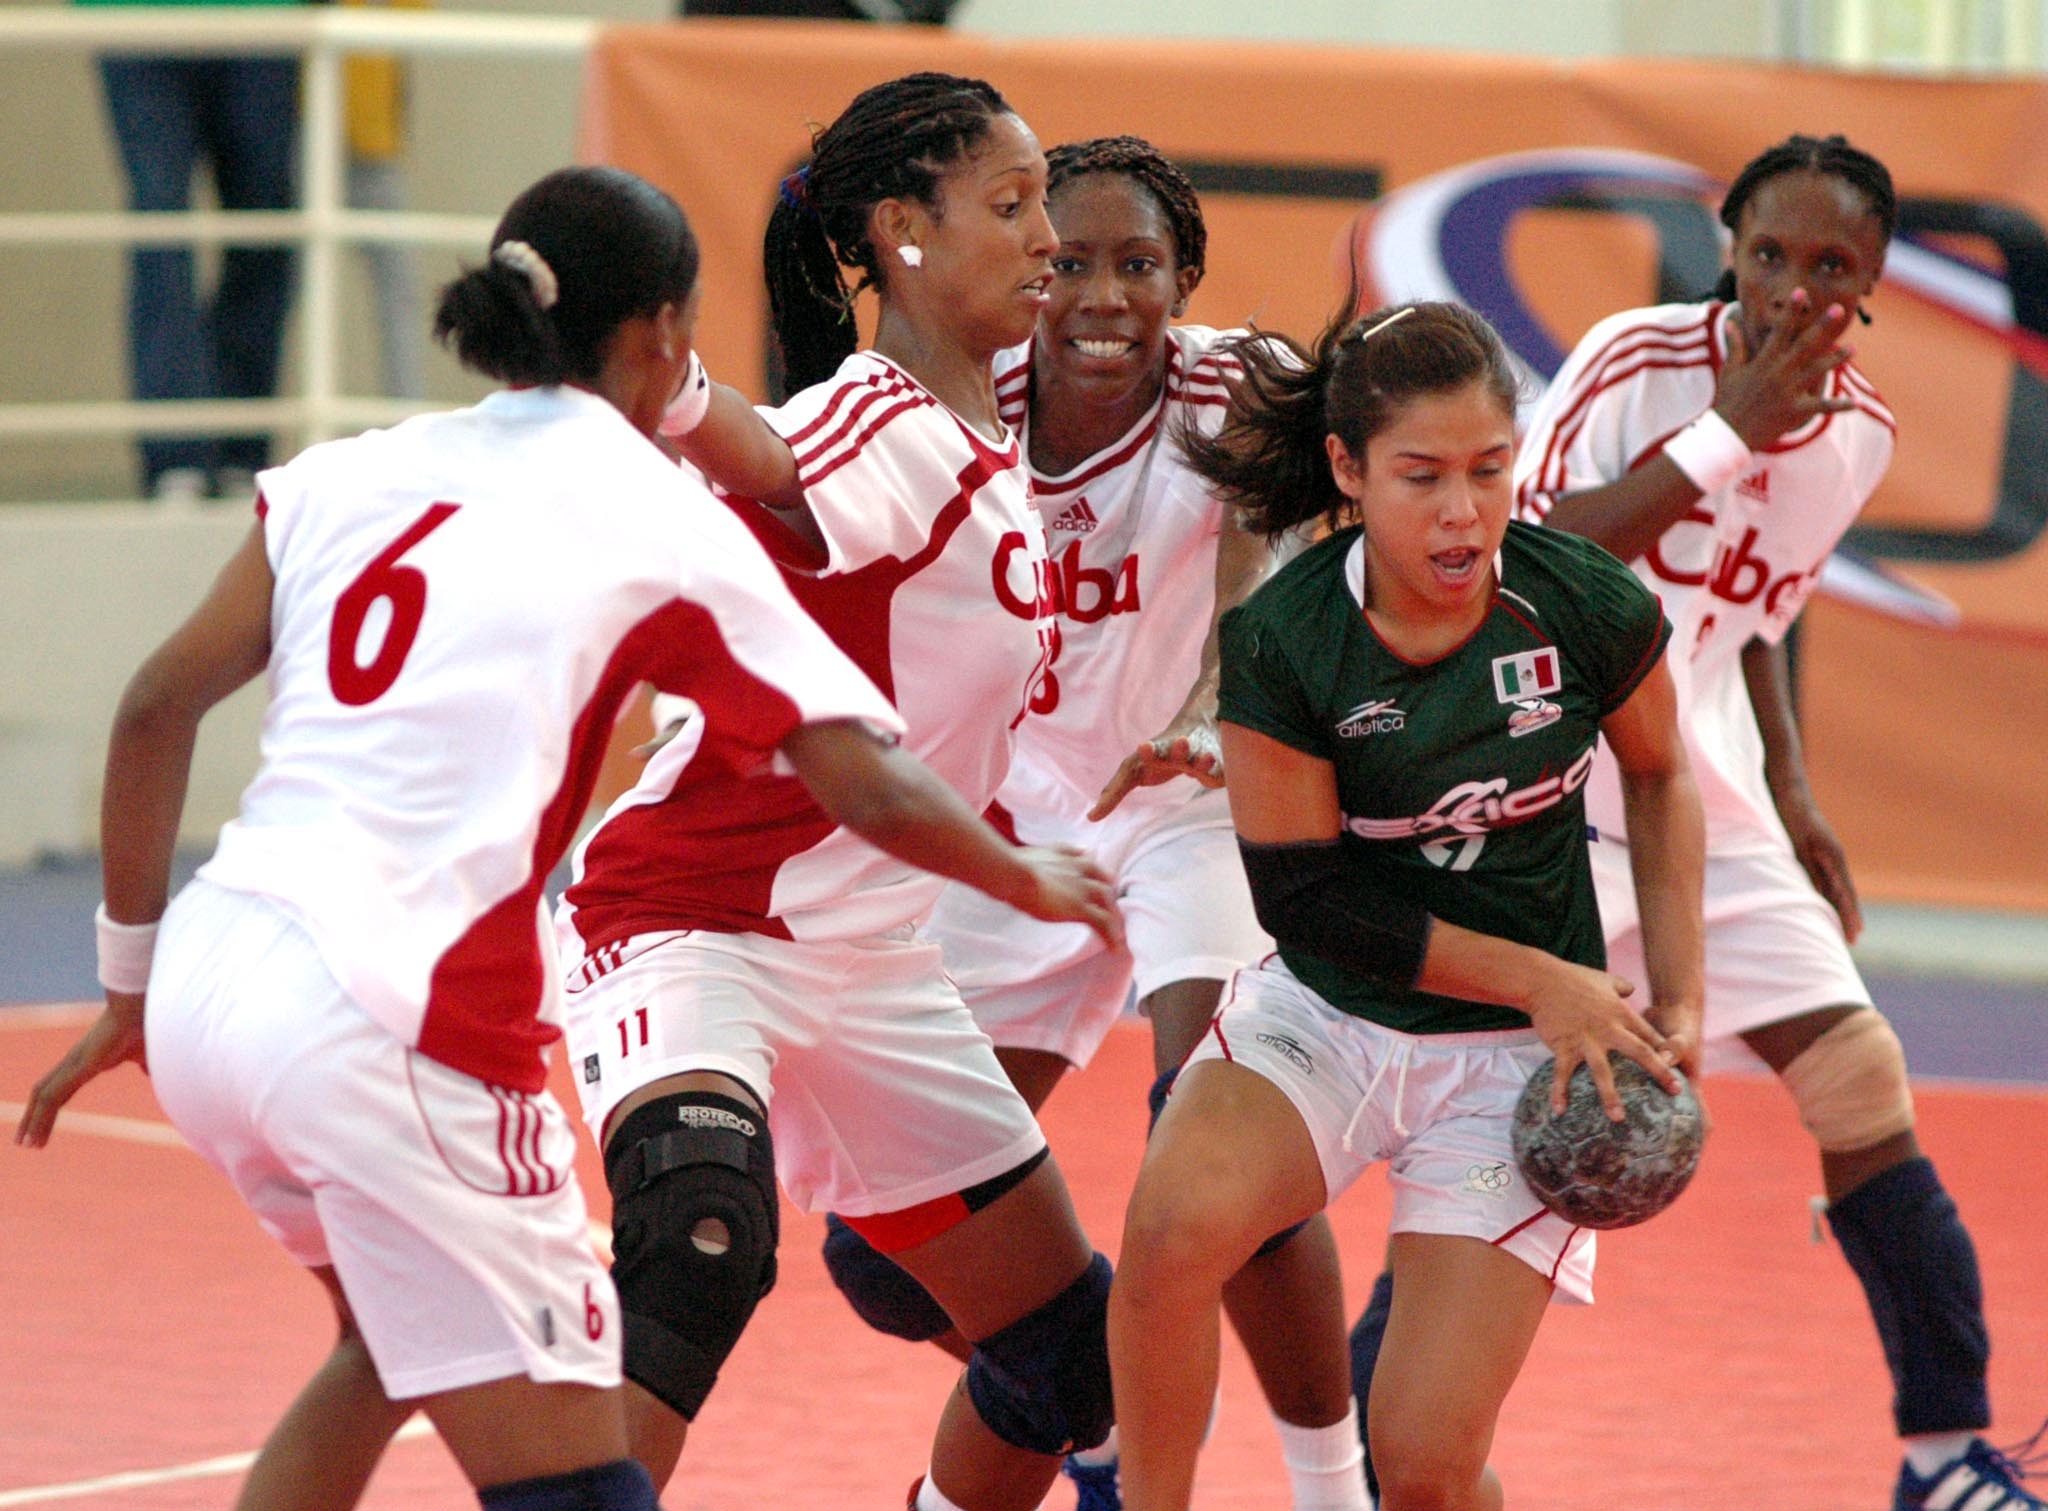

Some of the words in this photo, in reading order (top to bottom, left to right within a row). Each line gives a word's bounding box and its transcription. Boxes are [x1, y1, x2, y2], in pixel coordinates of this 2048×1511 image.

[327, 500, 462, 708] 6
[1338, 715, 1404, 738] atletica
[1340, 745, 1597, 839] exico
[617, 1006, 648, 1059] 11
[585, 1282, 603, 1341] 6
